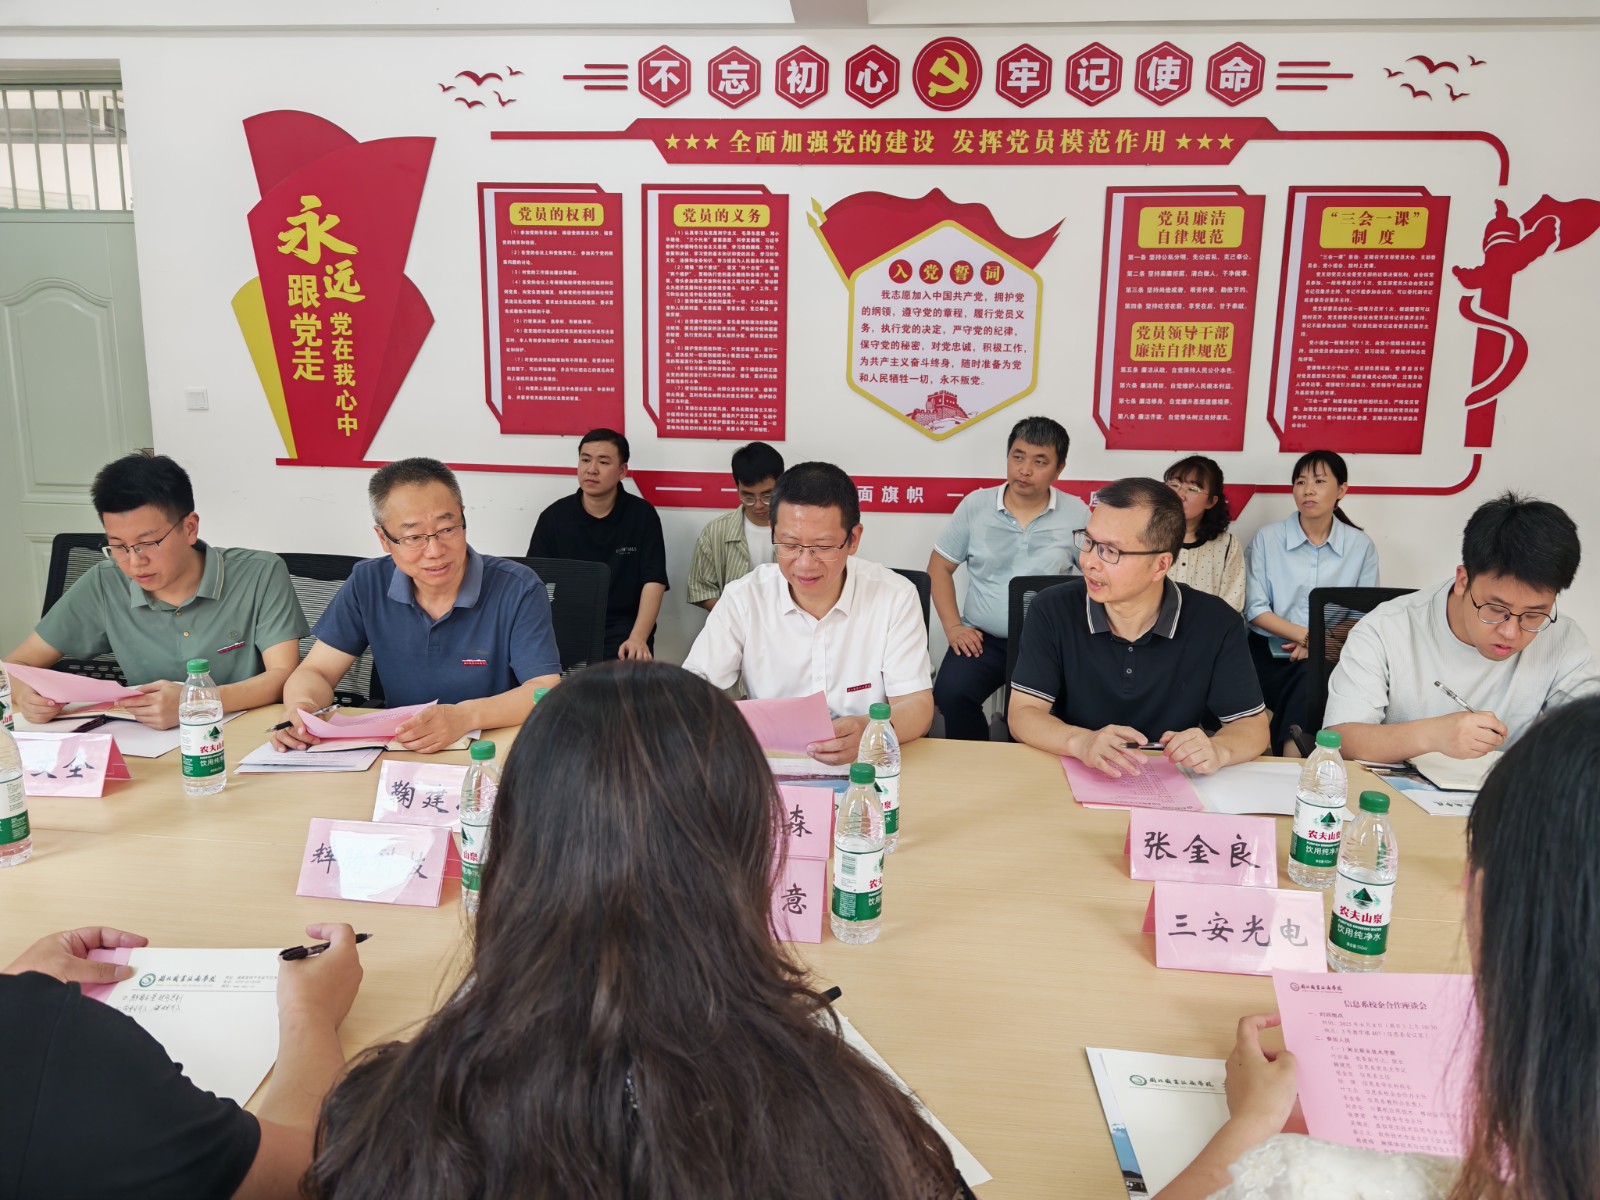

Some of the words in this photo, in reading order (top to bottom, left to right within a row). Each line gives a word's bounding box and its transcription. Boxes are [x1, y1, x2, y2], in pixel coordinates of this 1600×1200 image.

[649, 58, 888, 94] 不忘初心
[1006, 55, 1254, 93] 牢记使命
[729, 129, 935, 154] 全面加强党的建设
[952, 129, 1167, 154] 发挥党员模范作用
[518, 206, 596, 222] 党员的权利
[682, 207, 761, 223] 党员的义务
[1157, 209, 1227, 226] 党员廉洁
[1331, 210, 1420, 227] “三会一课”
[1157, 229, 1225, 245] 自律规范
[1351, 229, 1396, 245] 制度
[277, 194, 366, 303] 永远
[892, 263, 1001, 282] 入党誓词
[287, 274, 326, 382] 跟党走
[1135, 325, 1230, 341] 党员领导干部
[1134, 343, 1228, 358] 廉洁自律规范
[329, 311, 360, 437] 党在我心中
[857, 485, 924, 504] 面旗帜
[1144, 831, 1261, 869] 张金良
[781, 882, 807, 915] 意
[1340, 905, 1383, 924] 农夫山泉
[1168, 911, 1309, 947] 三安光电
[1337, 923, 1382, 942] 饮用纯净水
